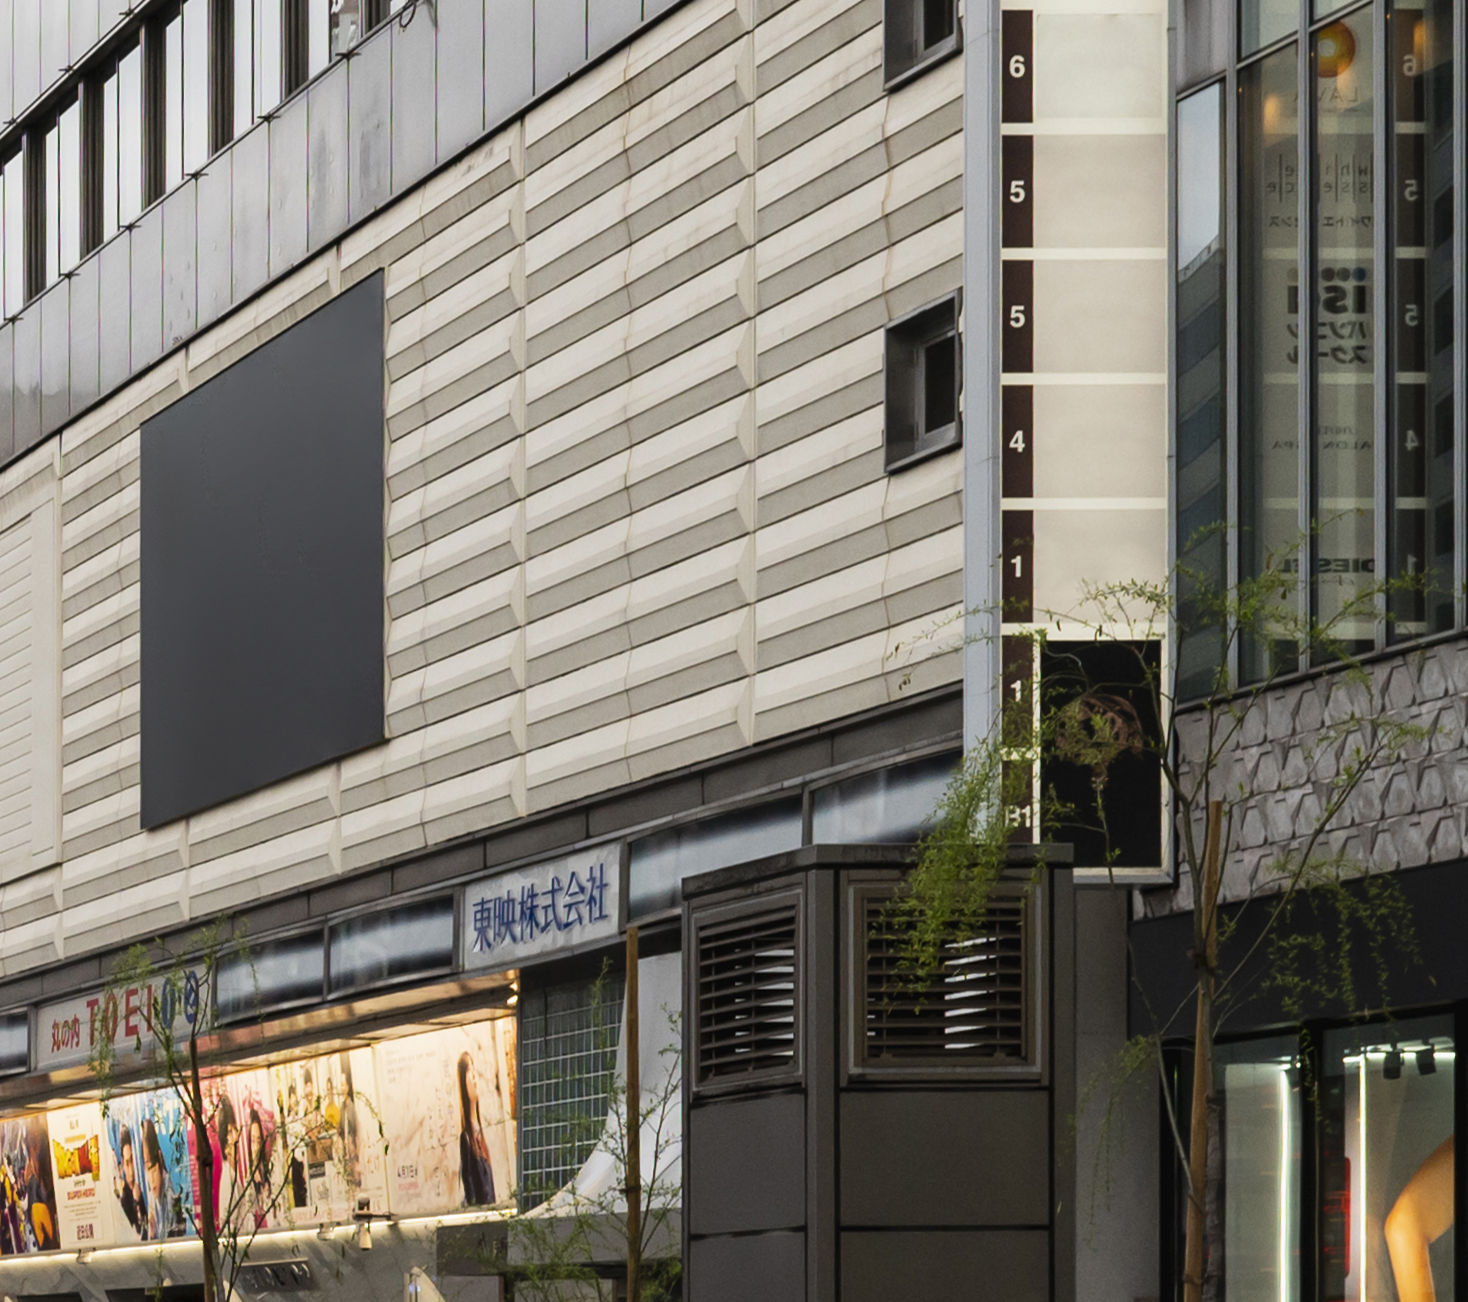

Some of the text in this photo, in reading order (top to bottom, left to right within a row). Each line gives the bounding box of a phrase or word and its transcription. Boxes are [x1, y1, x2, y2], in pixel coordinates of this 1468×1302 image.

[1009, 56, 1025, 78] 6
[1009, 181, 1025, 203] 5
[1009, 306, 1025, 328] 5
[1008, 431, 1025, 453] 4
[1011, 556, 1021, 577] 1
[1011, 680, 1021, 702] 1
[472, 863, 609, 952] 東映株式会社
[52, 1014, 81, 1053] 丸の内
[86, 984, 153, 1046] TOEI
